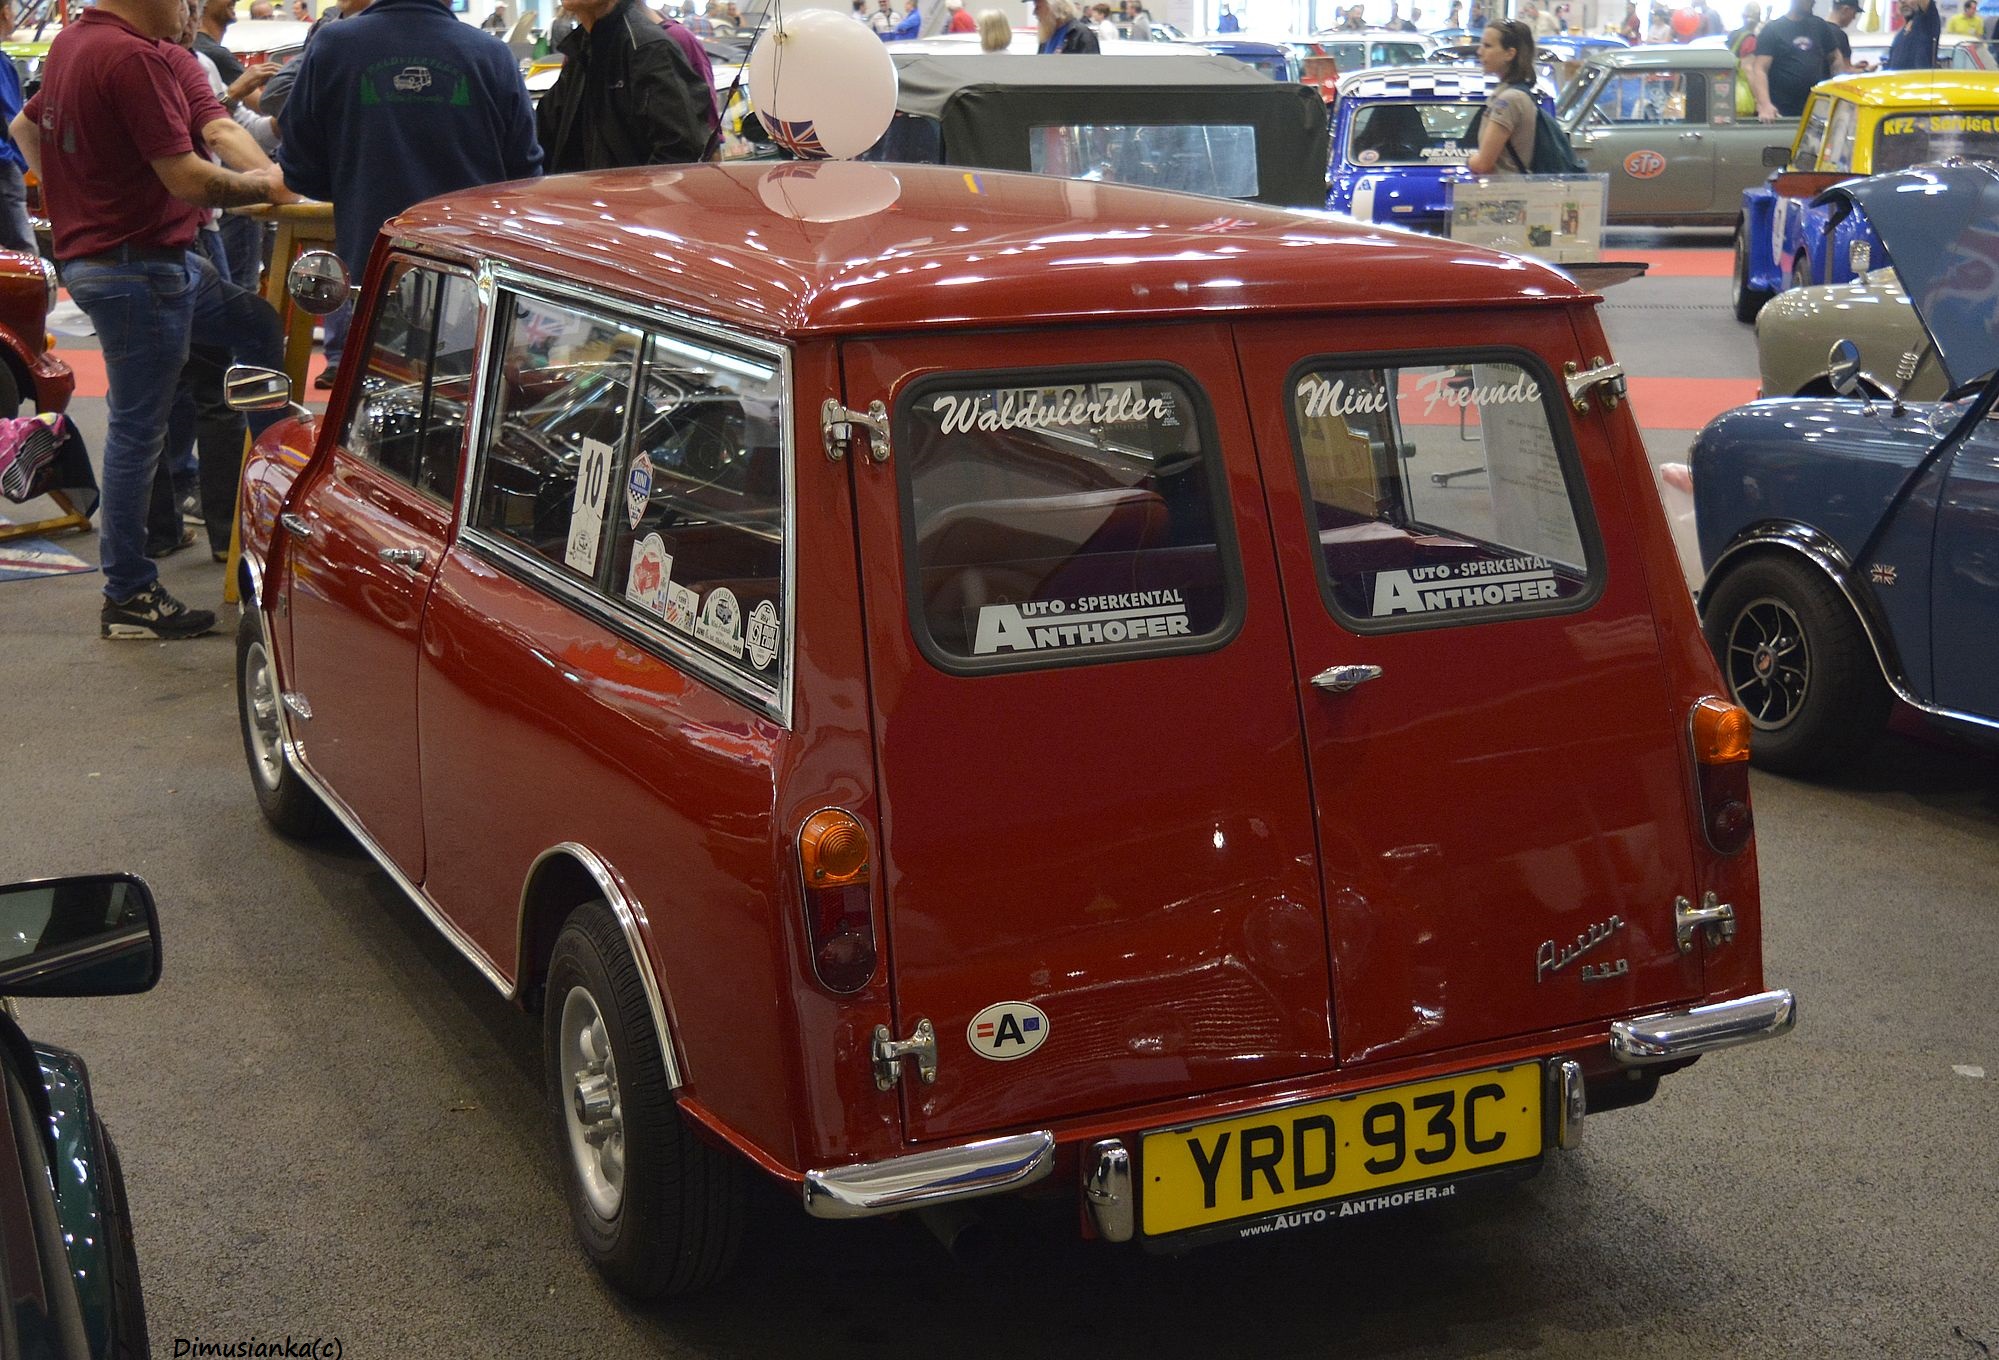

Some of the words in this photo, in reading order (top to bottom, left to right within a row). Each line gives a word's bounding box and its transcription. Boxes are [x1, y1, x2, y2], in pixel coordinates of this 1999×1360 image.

[1884, 117, 1914, 135] KFZ
[1930, 115, 1992, 133] Service
[1629, 153, 1660, 174] STP
[933, 387, 1168, 435] Waldviertler
[1298, 379, 1388, 418] Mini
[1417, 368, 1541, 416] Freunde
[583, 449, 604, 508] 10
[1461, 556, 1551, 577] SPERKENTAL
[1078, 588, 1183, 612] SPERKENTAL
[1372, 569, 1559, 617] ANTHOFER
[974, 604, 1192, 655] ANTHOFER
[993, 1013, 1026, 1048] A
[1186, 1114, 1336, 1209] YRD
[1363, 1083, 1506, 1175] 93C
